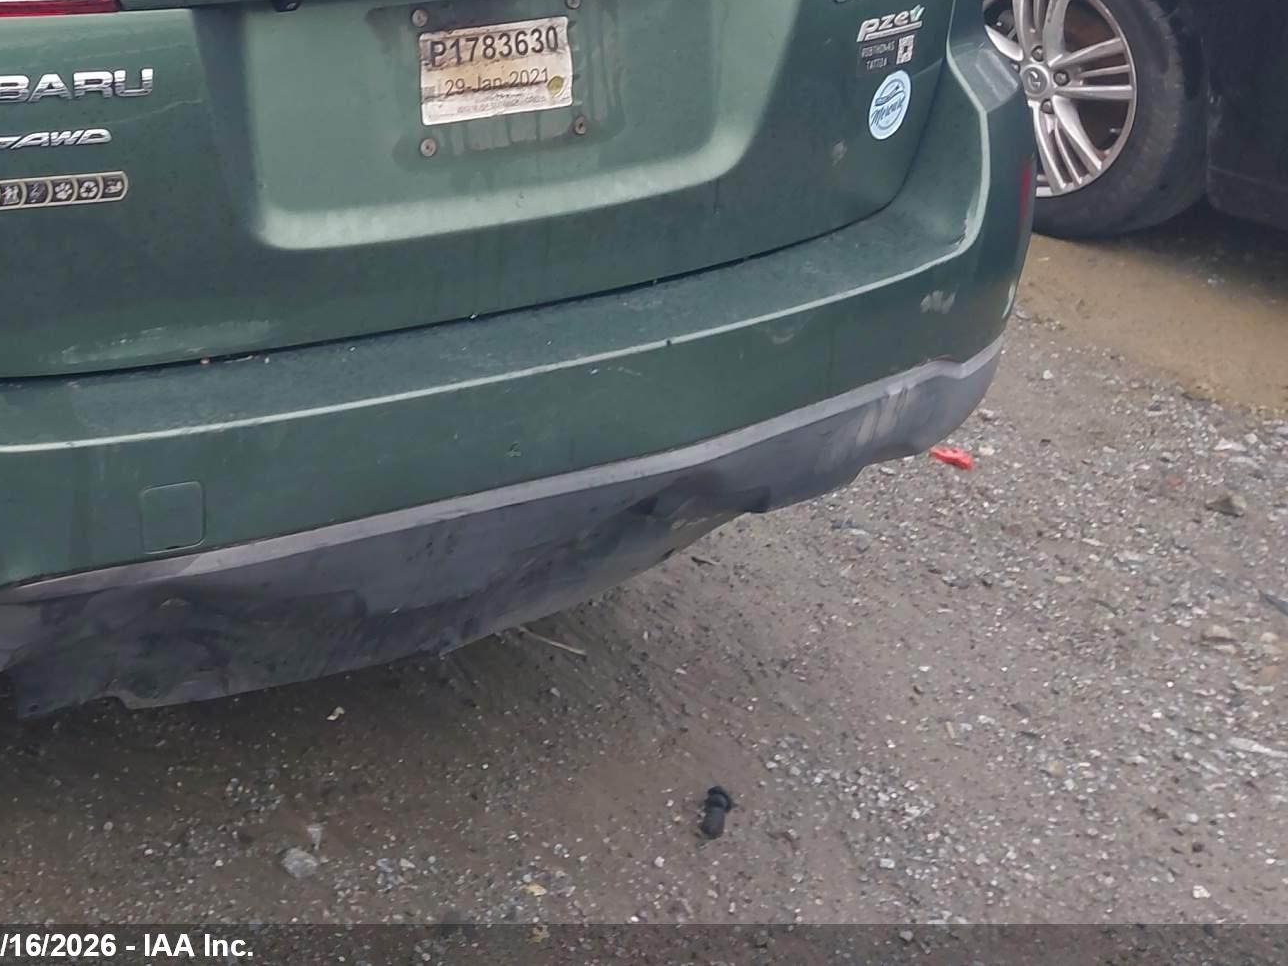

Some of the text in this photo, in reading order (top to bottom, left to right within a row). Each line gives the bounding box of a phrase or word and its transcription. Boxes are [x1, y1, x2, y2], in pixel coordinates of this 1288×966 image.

[429, 25, 559, 68] P1783630
[444, 67, 550, 98] 29-Jan-2021
[11, 128, 112, 149] AWD
